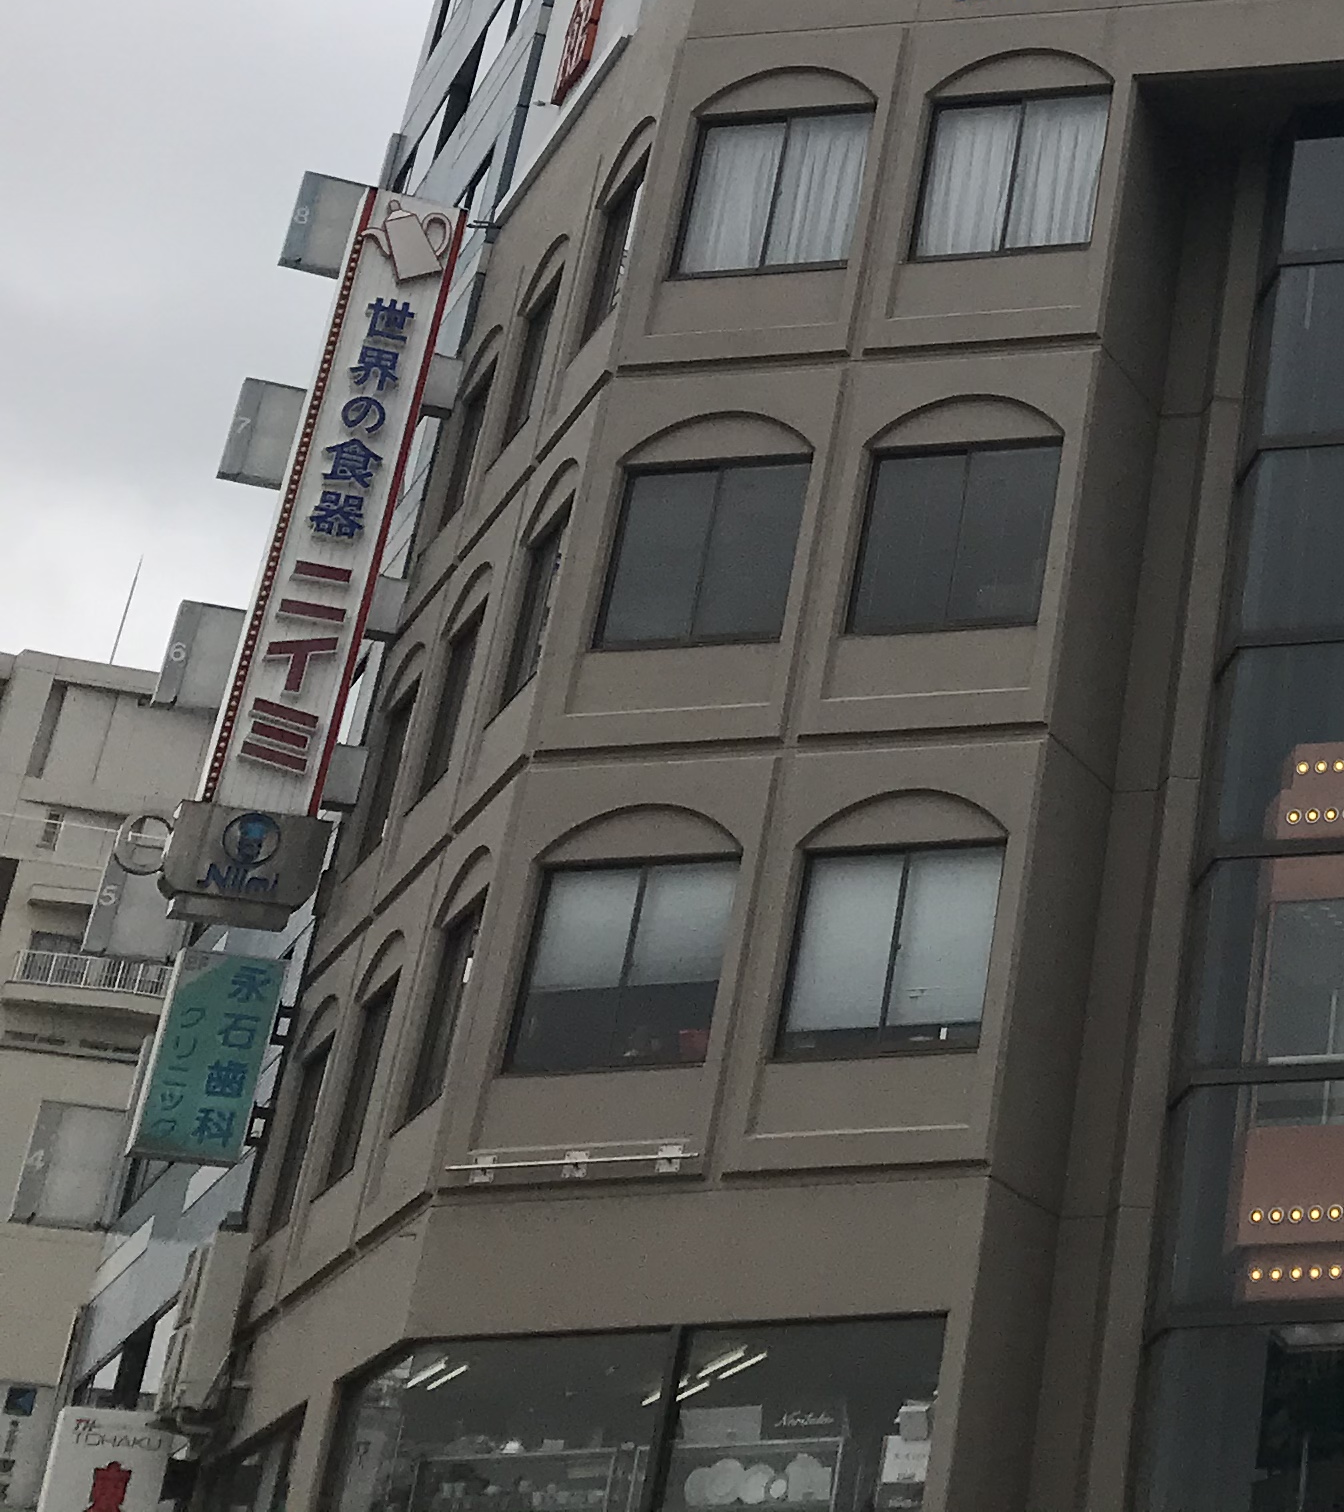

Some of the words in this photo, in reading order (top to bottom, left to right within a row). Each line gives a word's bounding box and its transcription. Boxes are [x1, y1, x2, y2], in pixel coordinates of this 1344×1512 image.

[308, 297, 415, 540] 世界の食器
[241, 559, 352, 773] ニイミ
[152, 1007, 206, 1136] クリニック
